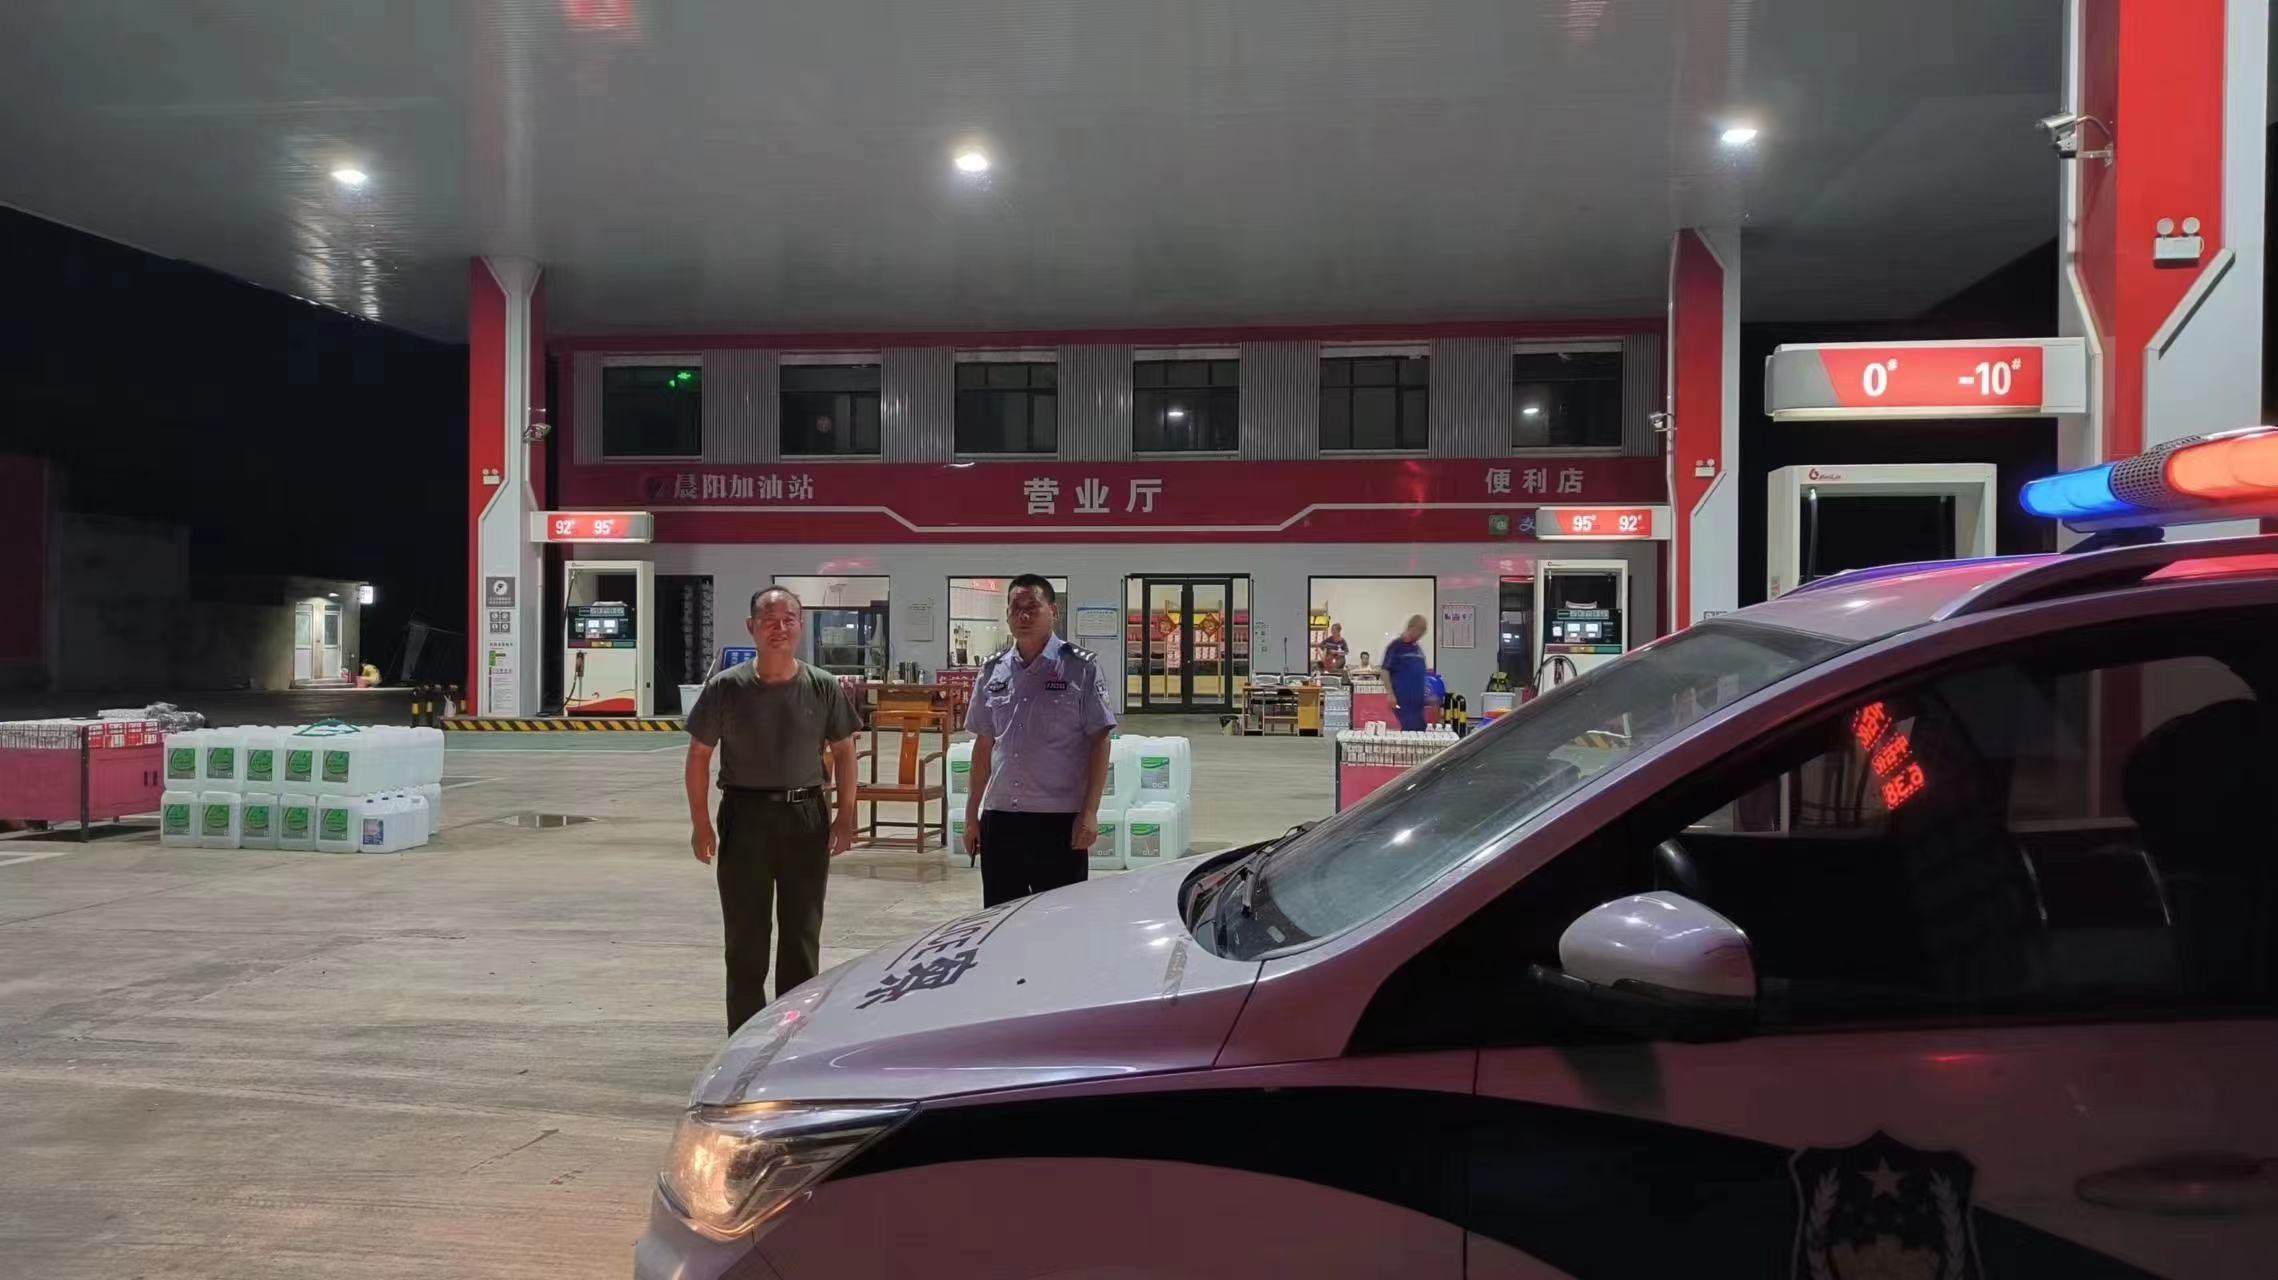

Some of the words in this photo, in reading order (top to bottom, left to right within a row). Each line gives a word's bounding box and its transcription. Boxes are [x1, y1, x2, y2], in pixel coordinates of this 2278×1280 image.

[1958, 357, 2022, 396] -10#
[674, 473, 814, 499] 晨阳加油站
[1023, 477, 1162, 515] 营业厅
[1485, 468, 1584, 494] 便利店
[855, 947, 979, 1009] 察
